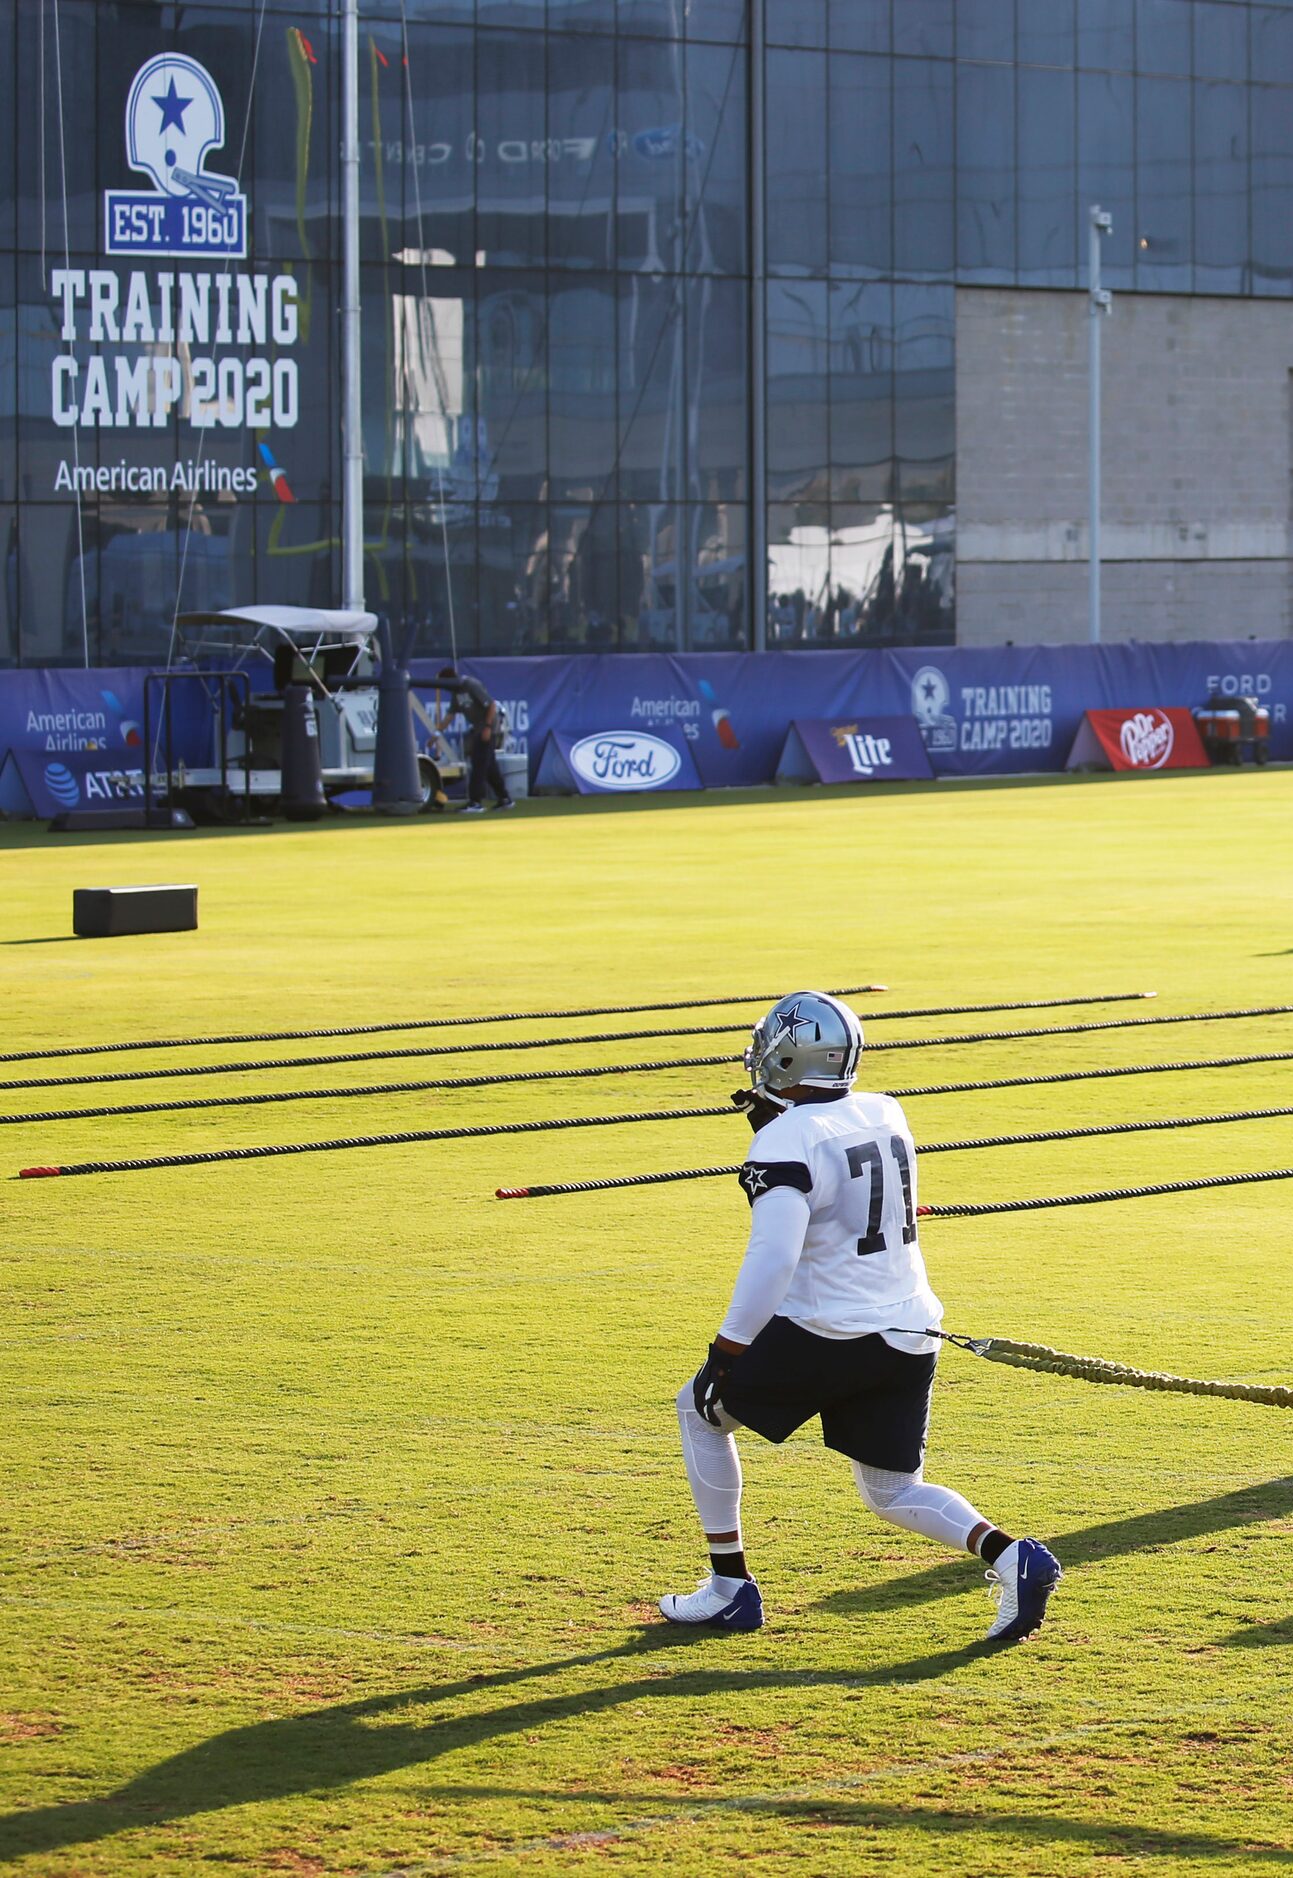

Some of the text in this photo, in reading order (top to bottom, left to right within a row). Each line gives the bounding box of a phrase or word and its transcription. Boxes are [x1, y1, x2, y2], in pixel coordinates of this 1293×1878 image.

[113, 203, 239, 245] EST. 1960
[52, 268, 298, 345] TRAINING
[52, 356, 298, 429] CAMP 2020
[54, 459, 258, 492] American Airlines
[961, 685, 1052, 716] TRAINING
[1206, 674, 1272, 694] FORD
[26, 708, 106, 732] American
[630, 696, 700, 717] American
[961, 721, 1006, 750] CAMP
[1010, 719, 1053, 748] 2020
[592, 740, 656, 778] Ford
[843, 734, 893, 776] Lite
[845, 1135, 917, 1257] 71
